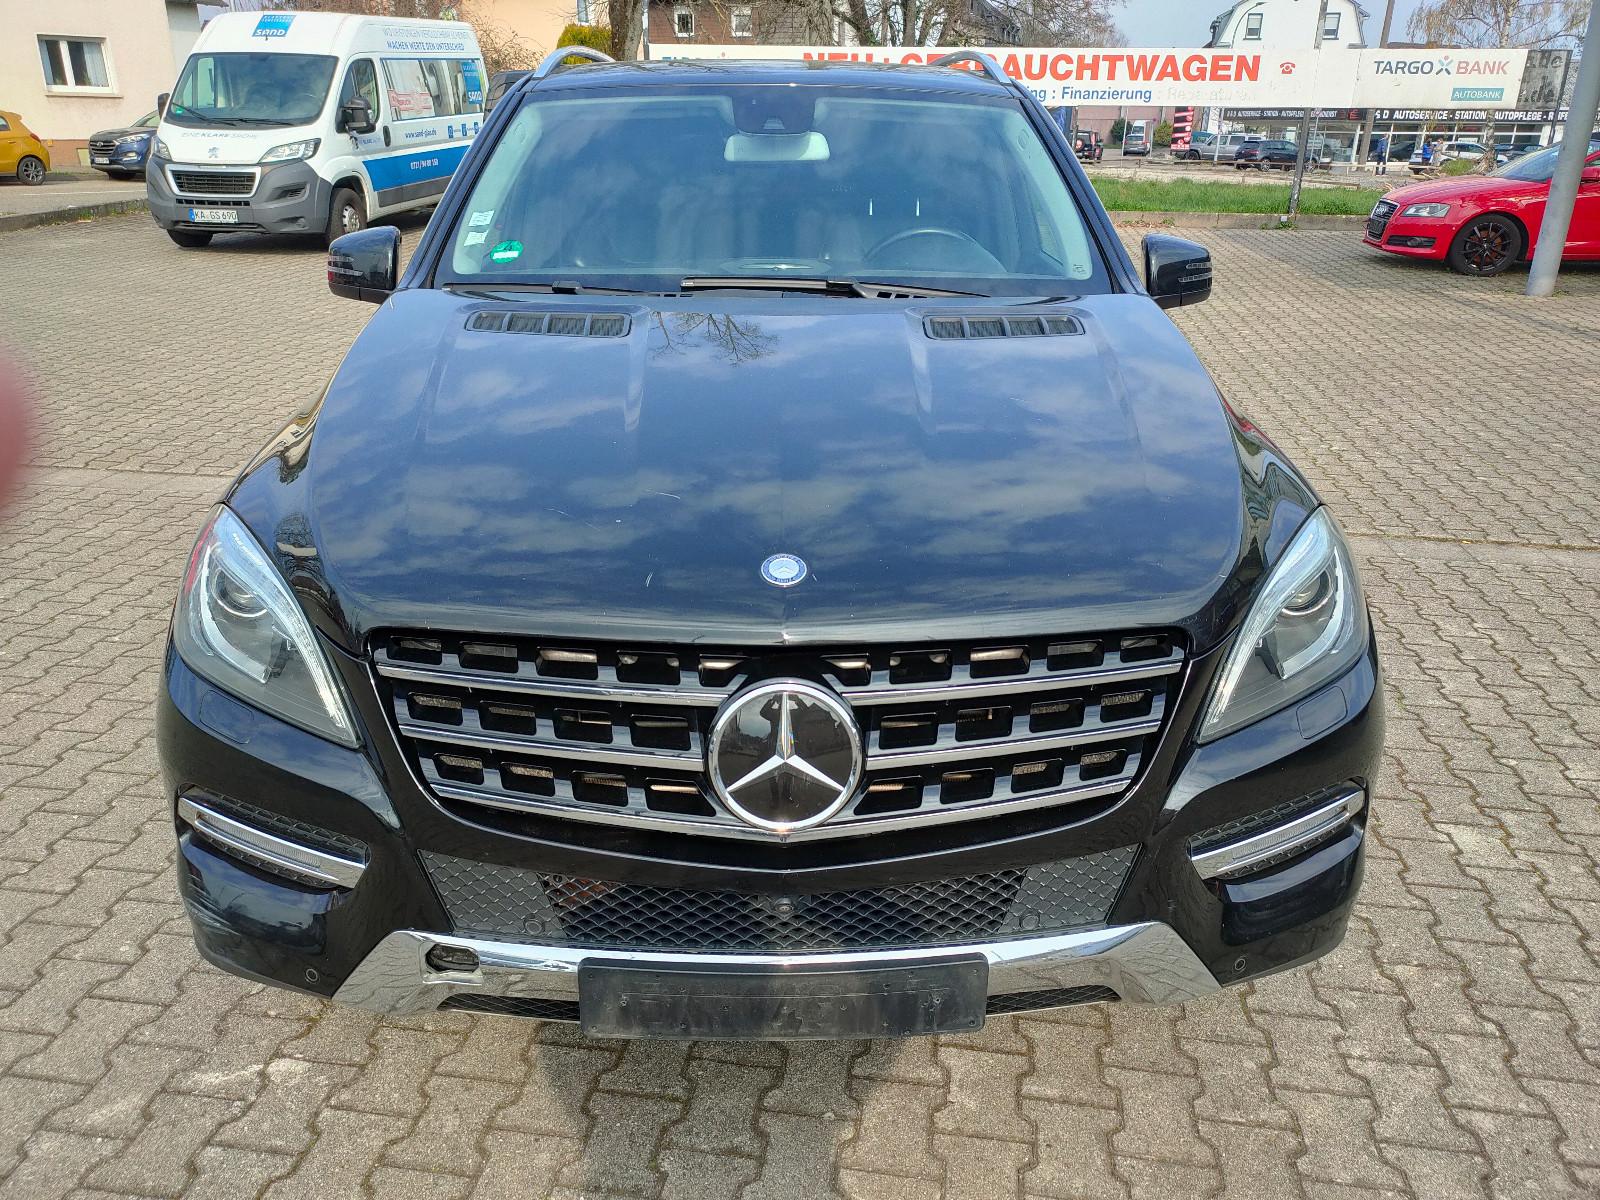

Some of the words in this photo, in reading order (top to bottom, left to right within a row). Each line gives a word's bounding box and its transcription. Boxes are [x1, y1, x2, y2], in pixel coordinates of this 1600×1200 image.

[1374, 60, 1434, 75] TARGO
[1456, 60, 1510, 75] BANK
[1061, 86, 1152, 103] Finanzierung
[1453, 90, 1502, 99] AUTOBANK
[1393, 110, 1449, 120] AUTOSERVICE
[1454, 110, 1487, 120] STATION
[1494, 111, 1543, 121] AUTOPFLEGE
